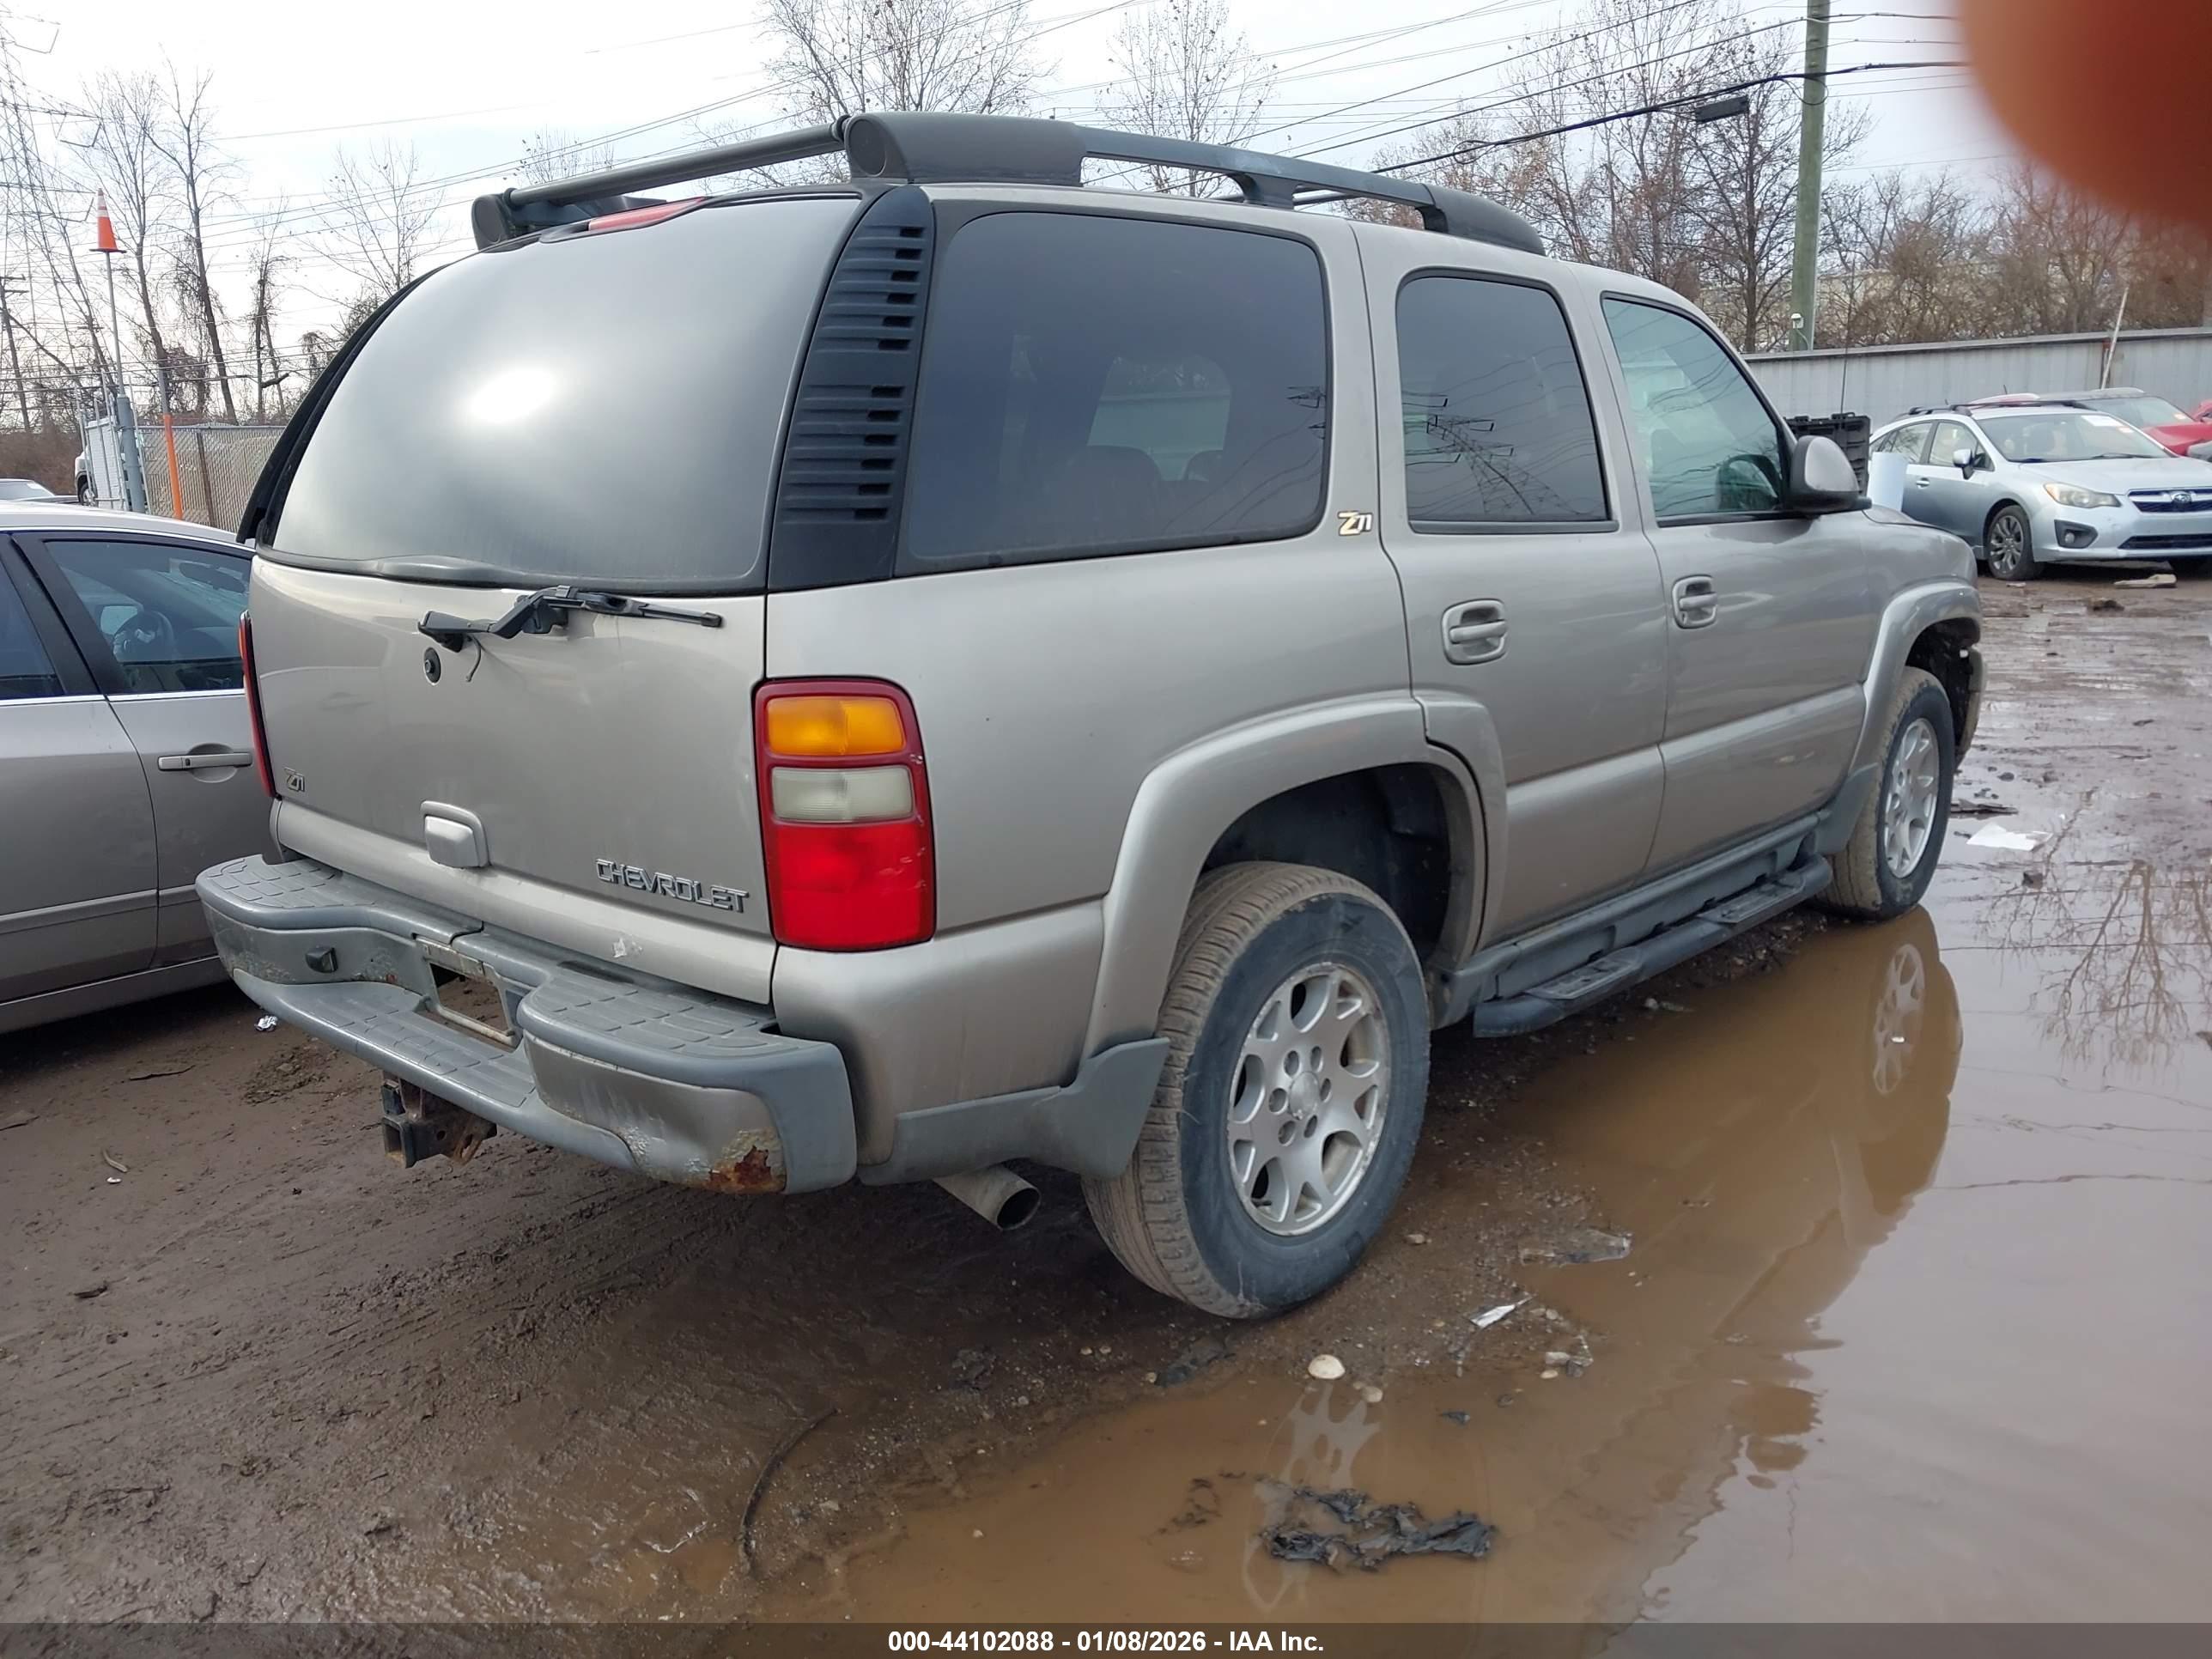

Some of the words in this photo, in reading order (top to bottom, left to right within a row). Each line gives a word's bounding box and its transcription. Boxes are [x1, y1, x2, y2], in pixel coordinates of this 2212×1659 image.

[1337, 510, 1373, 536] Z71
[283, 766, 305, 792] Z71
[596, 858, 750, 913] CHEVROLET
